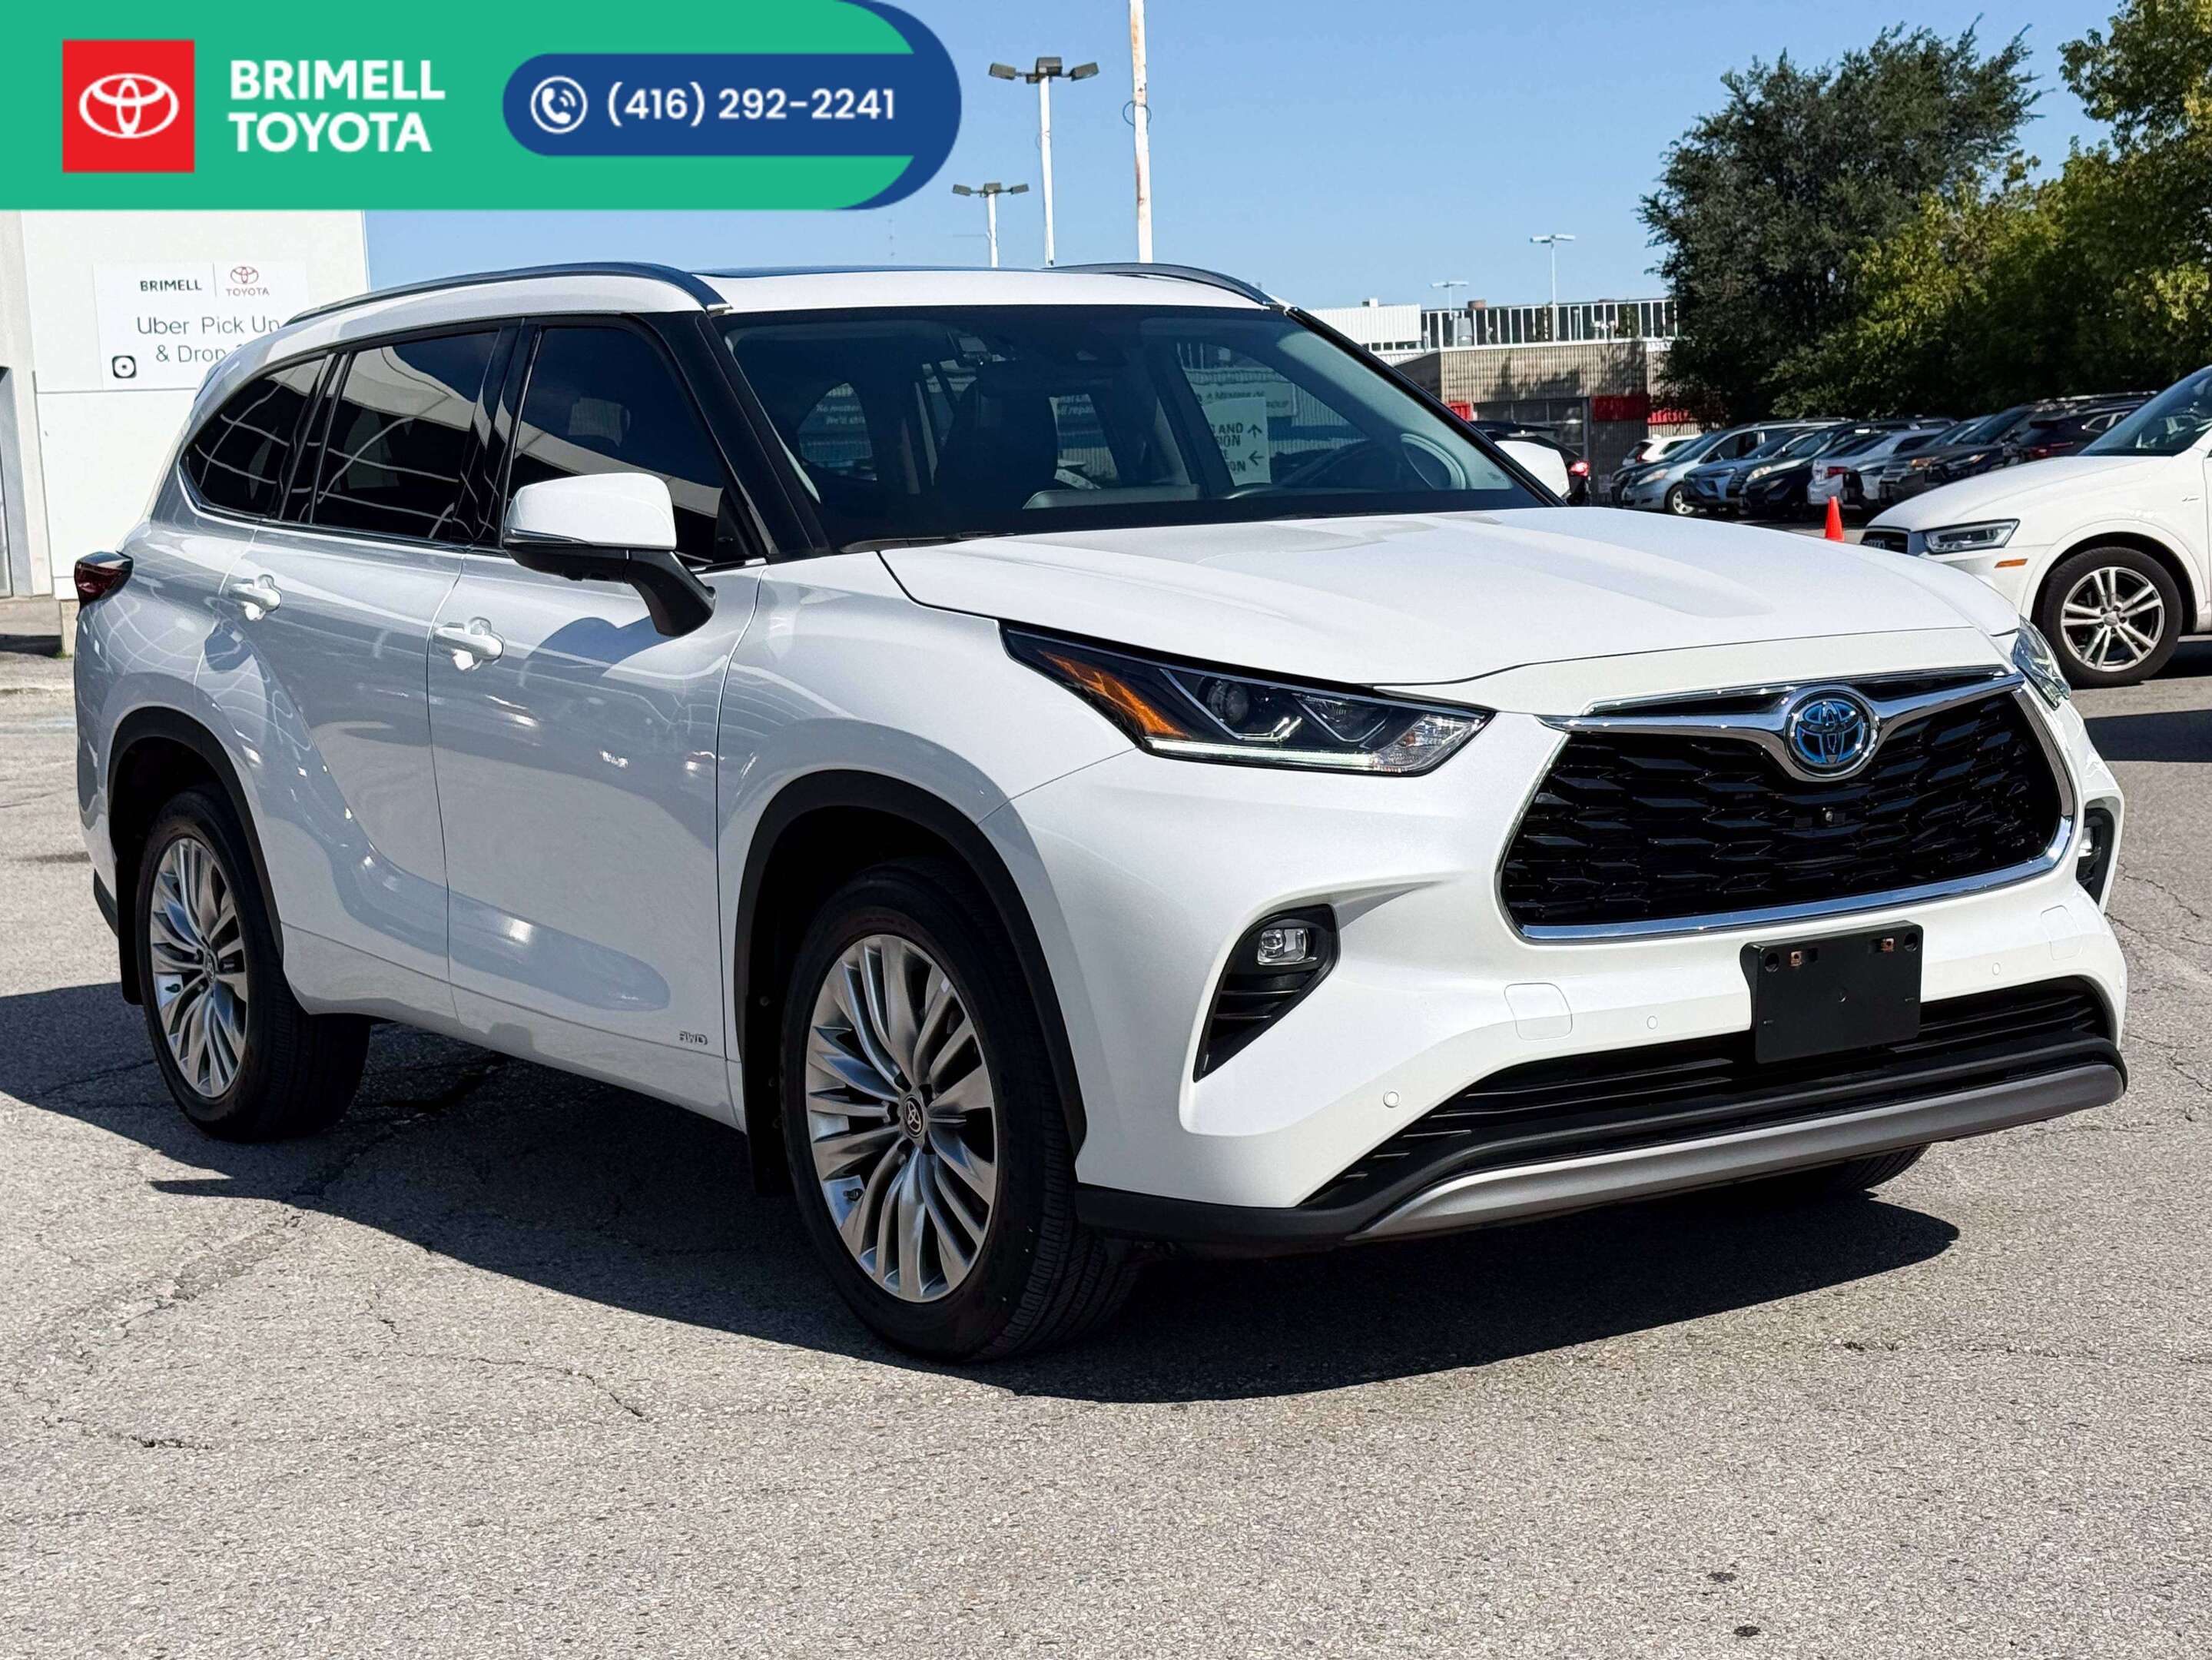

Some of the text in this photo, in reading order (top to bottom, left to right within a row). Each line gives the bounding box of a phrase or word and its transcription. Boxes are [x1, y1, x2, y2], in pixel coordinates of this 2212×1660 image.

[140, 279, 203, 292] BRIMELL
[225, 287, 270, 297] TOYOTA
[136, 316, 190, 335] Uber
[201, 315, 245, 335] Pick
[155, 344, 170, 363] &
[1218, 422, 1244, 434] AND
